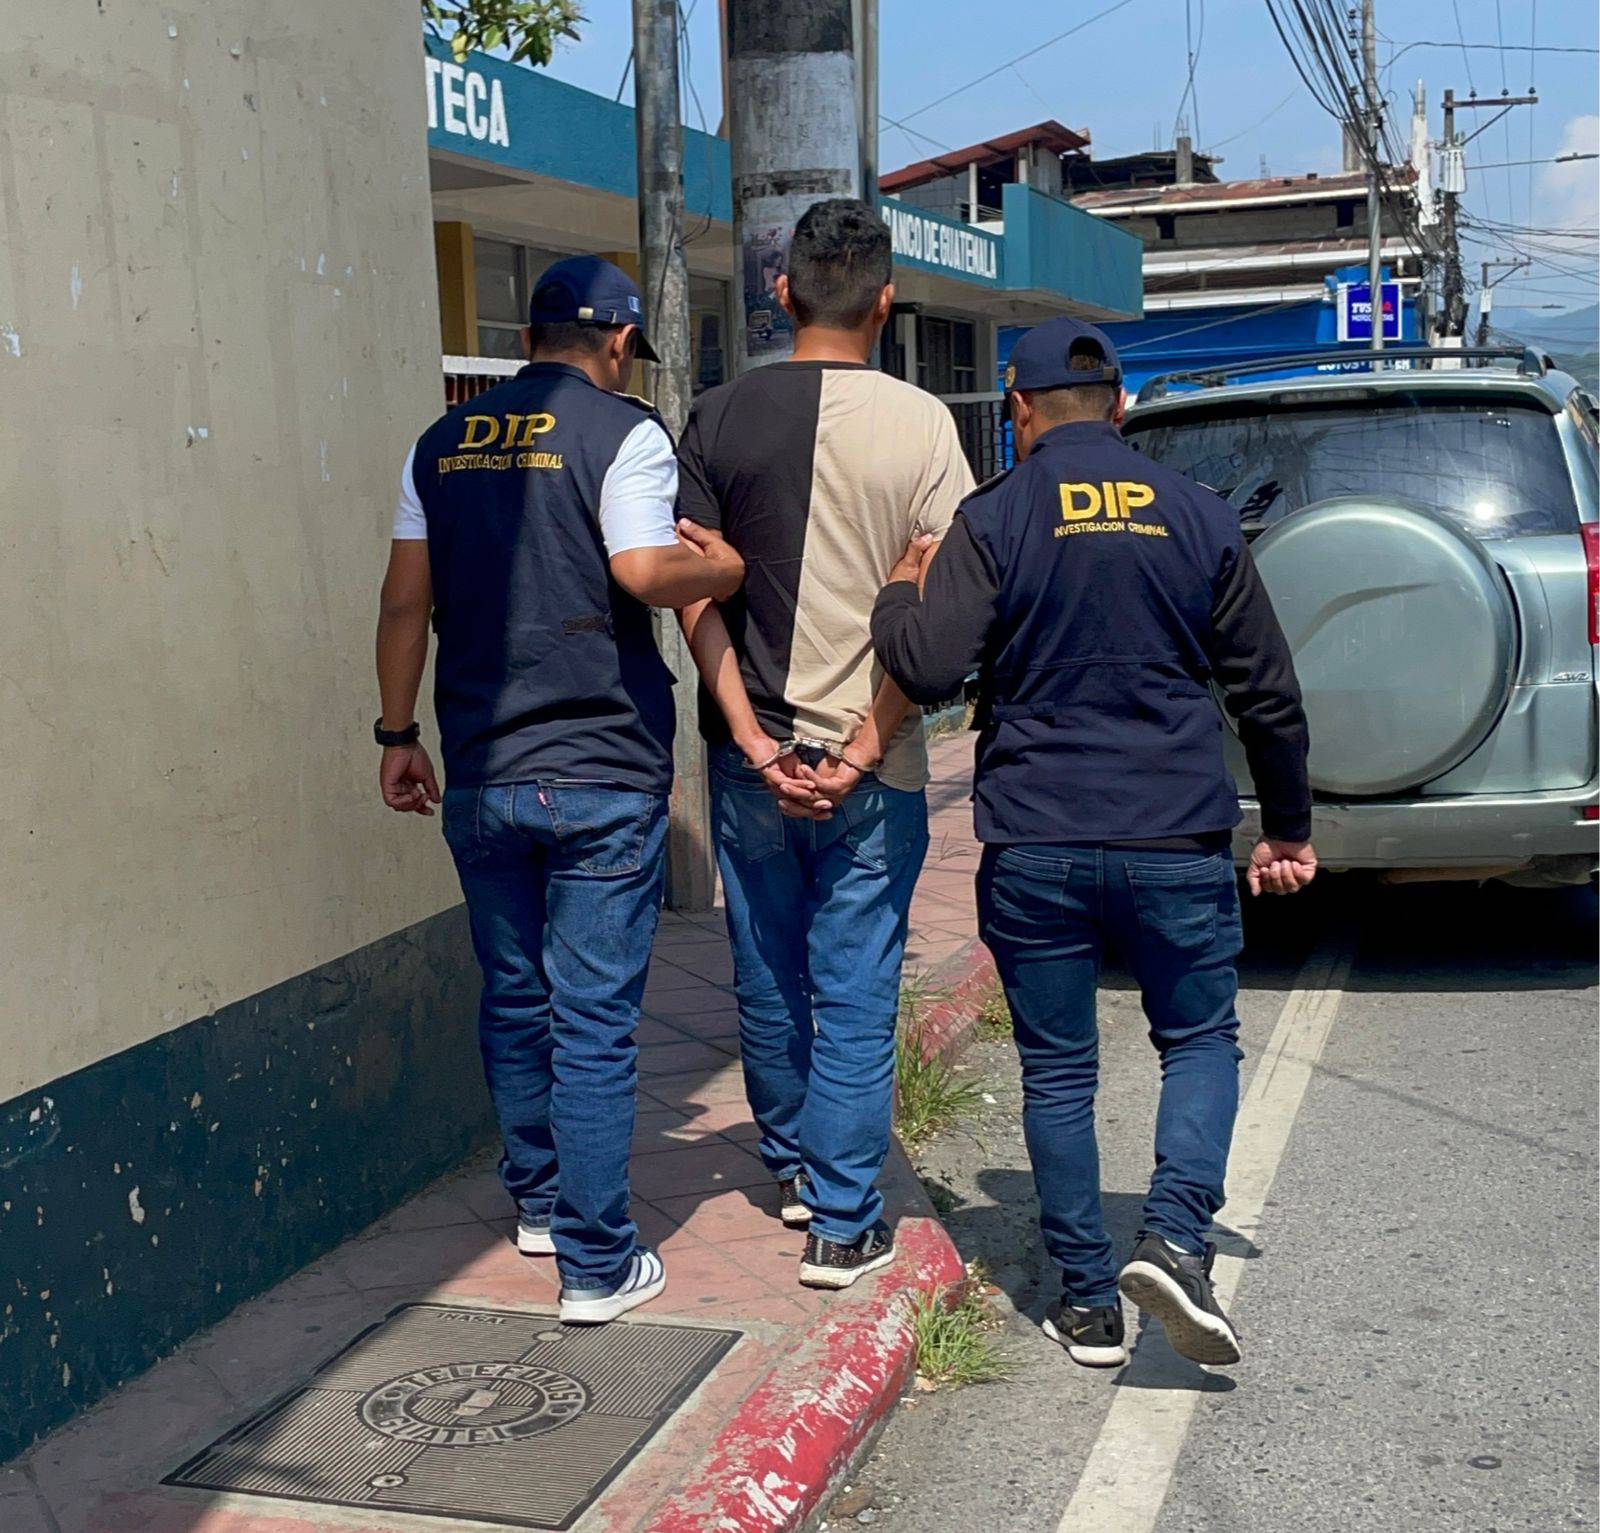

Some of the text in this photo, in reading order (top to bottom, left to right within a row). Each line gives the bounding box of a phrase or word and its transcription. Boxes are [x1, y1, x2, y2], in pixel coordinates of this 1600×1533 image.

[424, 56, 510, 148] TECA
[923, 219, 940, 264] DE
[940, 224, 998, 279] GUATEMALA
[458, 412, 557, 450] DIP
[516, 452, 563, 469] CRIMINAL
[1059, 481, 1156, 521] DIP
[1054, 521, 1169, 538] INVESTIGACION CRIMINAL
[399, 1363, 583, 1402] TELEFONOS
